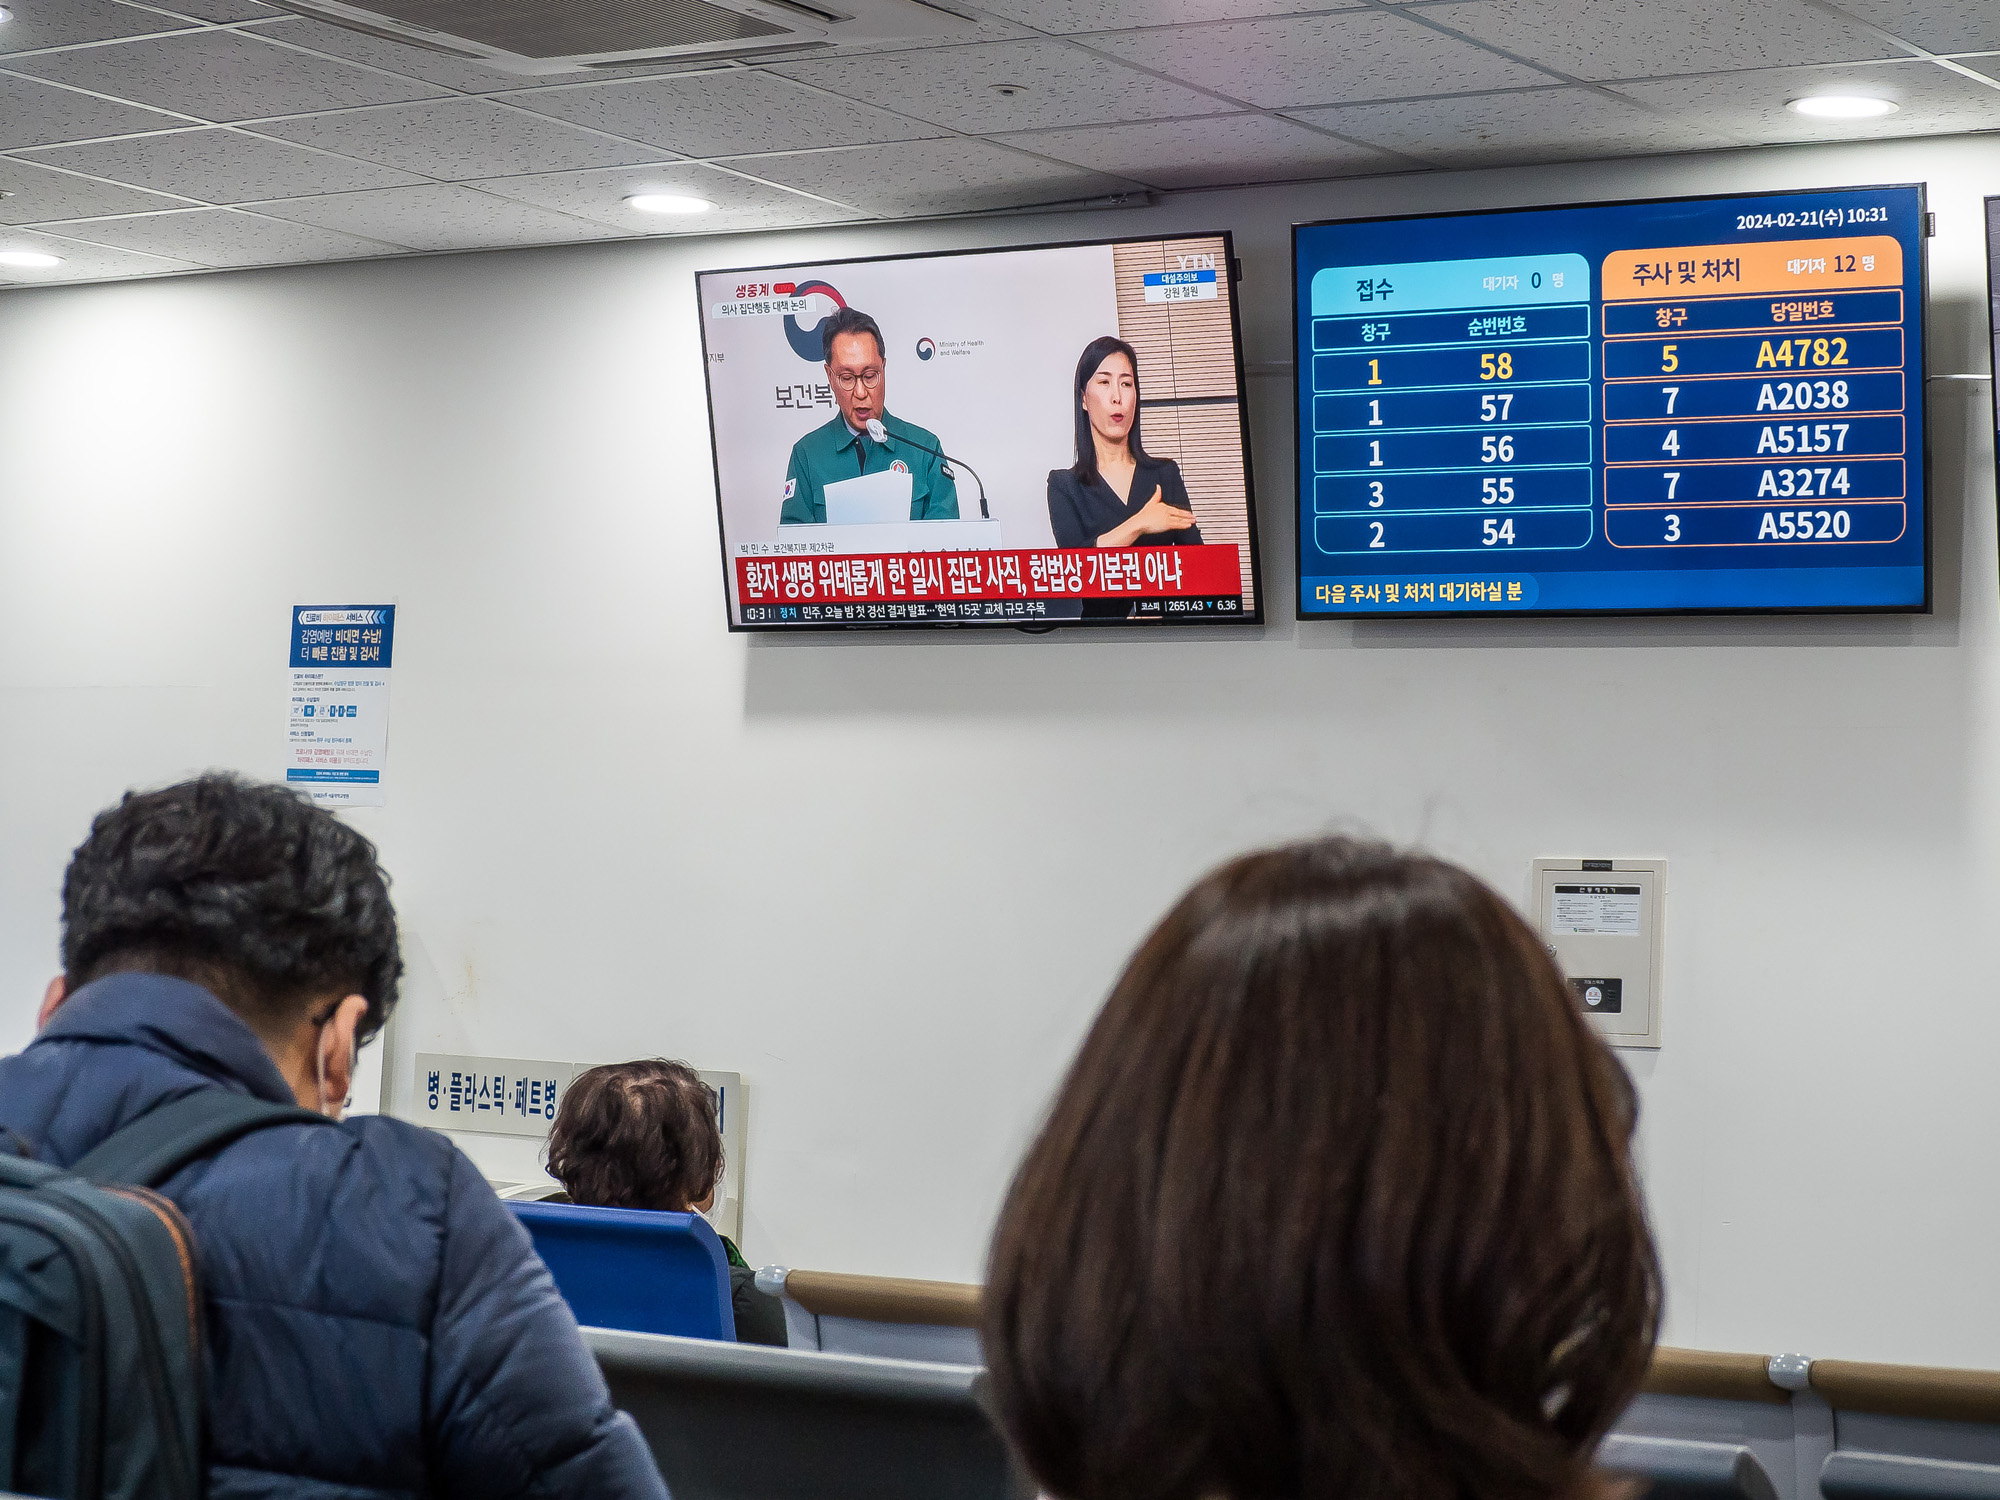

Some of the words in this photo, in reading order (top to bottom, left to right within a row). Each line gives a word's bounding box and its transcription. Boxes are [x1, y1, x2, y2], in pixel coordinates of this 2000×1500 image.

[1737, 208, 1845, 230] 2024-02-21(수)
[1847, 206, 1888, 224] 10:31
[1177, 253, 1216, 271] YTN
[1633, 261, 1672, 286] 주사
[1678, 259, 1696, 285] 및
[1701, 257, 1741, 283] 처치
[1787, 258, 1826, 275] 대기자
[1834, 254, 1857, 272] 12
[1862, 255, 1875, 272] 명
[735, 283, 770, 298] 생중계
[1161, 273, 1199, 285] 대설주의보
[1163, 286, 1180, 299] 강원
[1182, 285, 1199, 298] 철원
[1356, 278, 1394, 302] 접수
[1483, 275, 1519, 291] 대기자
[1531, 271, 1541, 289] 0
[1552, 272, 1564, 288] 명
[721, 304, 737, 315] 의사
[739, 302, 771, 315] 집단행동
[772, 300, 789, 312] 대책
[790, 299, 807, 311] 논의
[1655, 308, 1688, 327] 창구
[1771, 300, 1835, 322] 당일번호
[1361, 323, 1391, 342] 창구
[1467, 316, 1527, 337] 순번번호
[708, 353, 725, 363] 지부
[1661, 345, 1678, 372] 5
[1755, 337, 1849, 368] A4782
[1368, 359, 1383, 385] 1
[1480, 353, 1513, 380] 58
[776, 384, 839, 409] 보건복
[1662, 387, 1680, 414] 7
[1756, 380, 1849, 411] A2038
[1368, 400, 1383, 426] 1
[1480, 394, 1514, 421] 57
[1369, 440, 1384, 467] 1
[1481, 435, 1514, 463] 56
[1661, 429, 1680, 456] 4
[1756, 424, 1850, 454] A5157
[1368, 481, 1384, 508] 3
[1481, 477, 1515, 505] 55
[1663, 472, 1681, 499] 7
[1757, 467, 1850, 497] A3274
[1369, 521, 1385, 548] 2
[1481, 518, 1516, 545] 54
[1663, 514, 1681, 542] 3
[1757, 510, 1851, 540] A5520
[745, 560, 779, 599] 환자
[782, 559, 815, 599] 생명
[818, 558, 886, 597] 위태롭게
[888, 558, 906, 596] 한
[909, 557, 944, 596] 일시
[947, 556, 982, 595] 집단
[986, 554, 1027, 597] 사직,
[1029, 553, 1082, 594] 헌법상
[1086, 552, 1142, 592] 기본권
[1144, 551, 1182, 590] 아냐
[1315, 584, 1346, 604] 다음
[1350, 583, 1380, 604] 주사
[1384, 583, 1400, 603] 및
[1404, 582, 1434, 603] 처치
[1439, 581, 1502, 602] 대기하실
[1506, 580, 1523, 601] 분
[780, 607, 797, 619] 정치
[825, 606, 843, 619] 오늘
[844, 605, 855, 619] 밤
[856, 604, 866, 618] 첫
[867, 604, 886, 618] 경선
[887, 604, 906, 618] 결과
[984, 603, 1004, 616] 교체
[1005, 602, 1025, 615] 규모
[1026, 602, 1046, 615] 주목
[1141, 602, 1160, 612] 코스피
[1168, 600, 1204, 612] 2651.43
[1217, 600, 1237, 612] 6.36
[301, 629, 334, 644] 감염예방
[335, 629, 360, 644] 비대면
[361, 628, 382, 644] 수납!
[301, 646, 309, 661] 더
[311, 646, 329, 661] 빠른
[330, 646, 348, 661] 진찰
[349, 646, 358, 661] 및
[360, 646, 380, 661] 검사!
